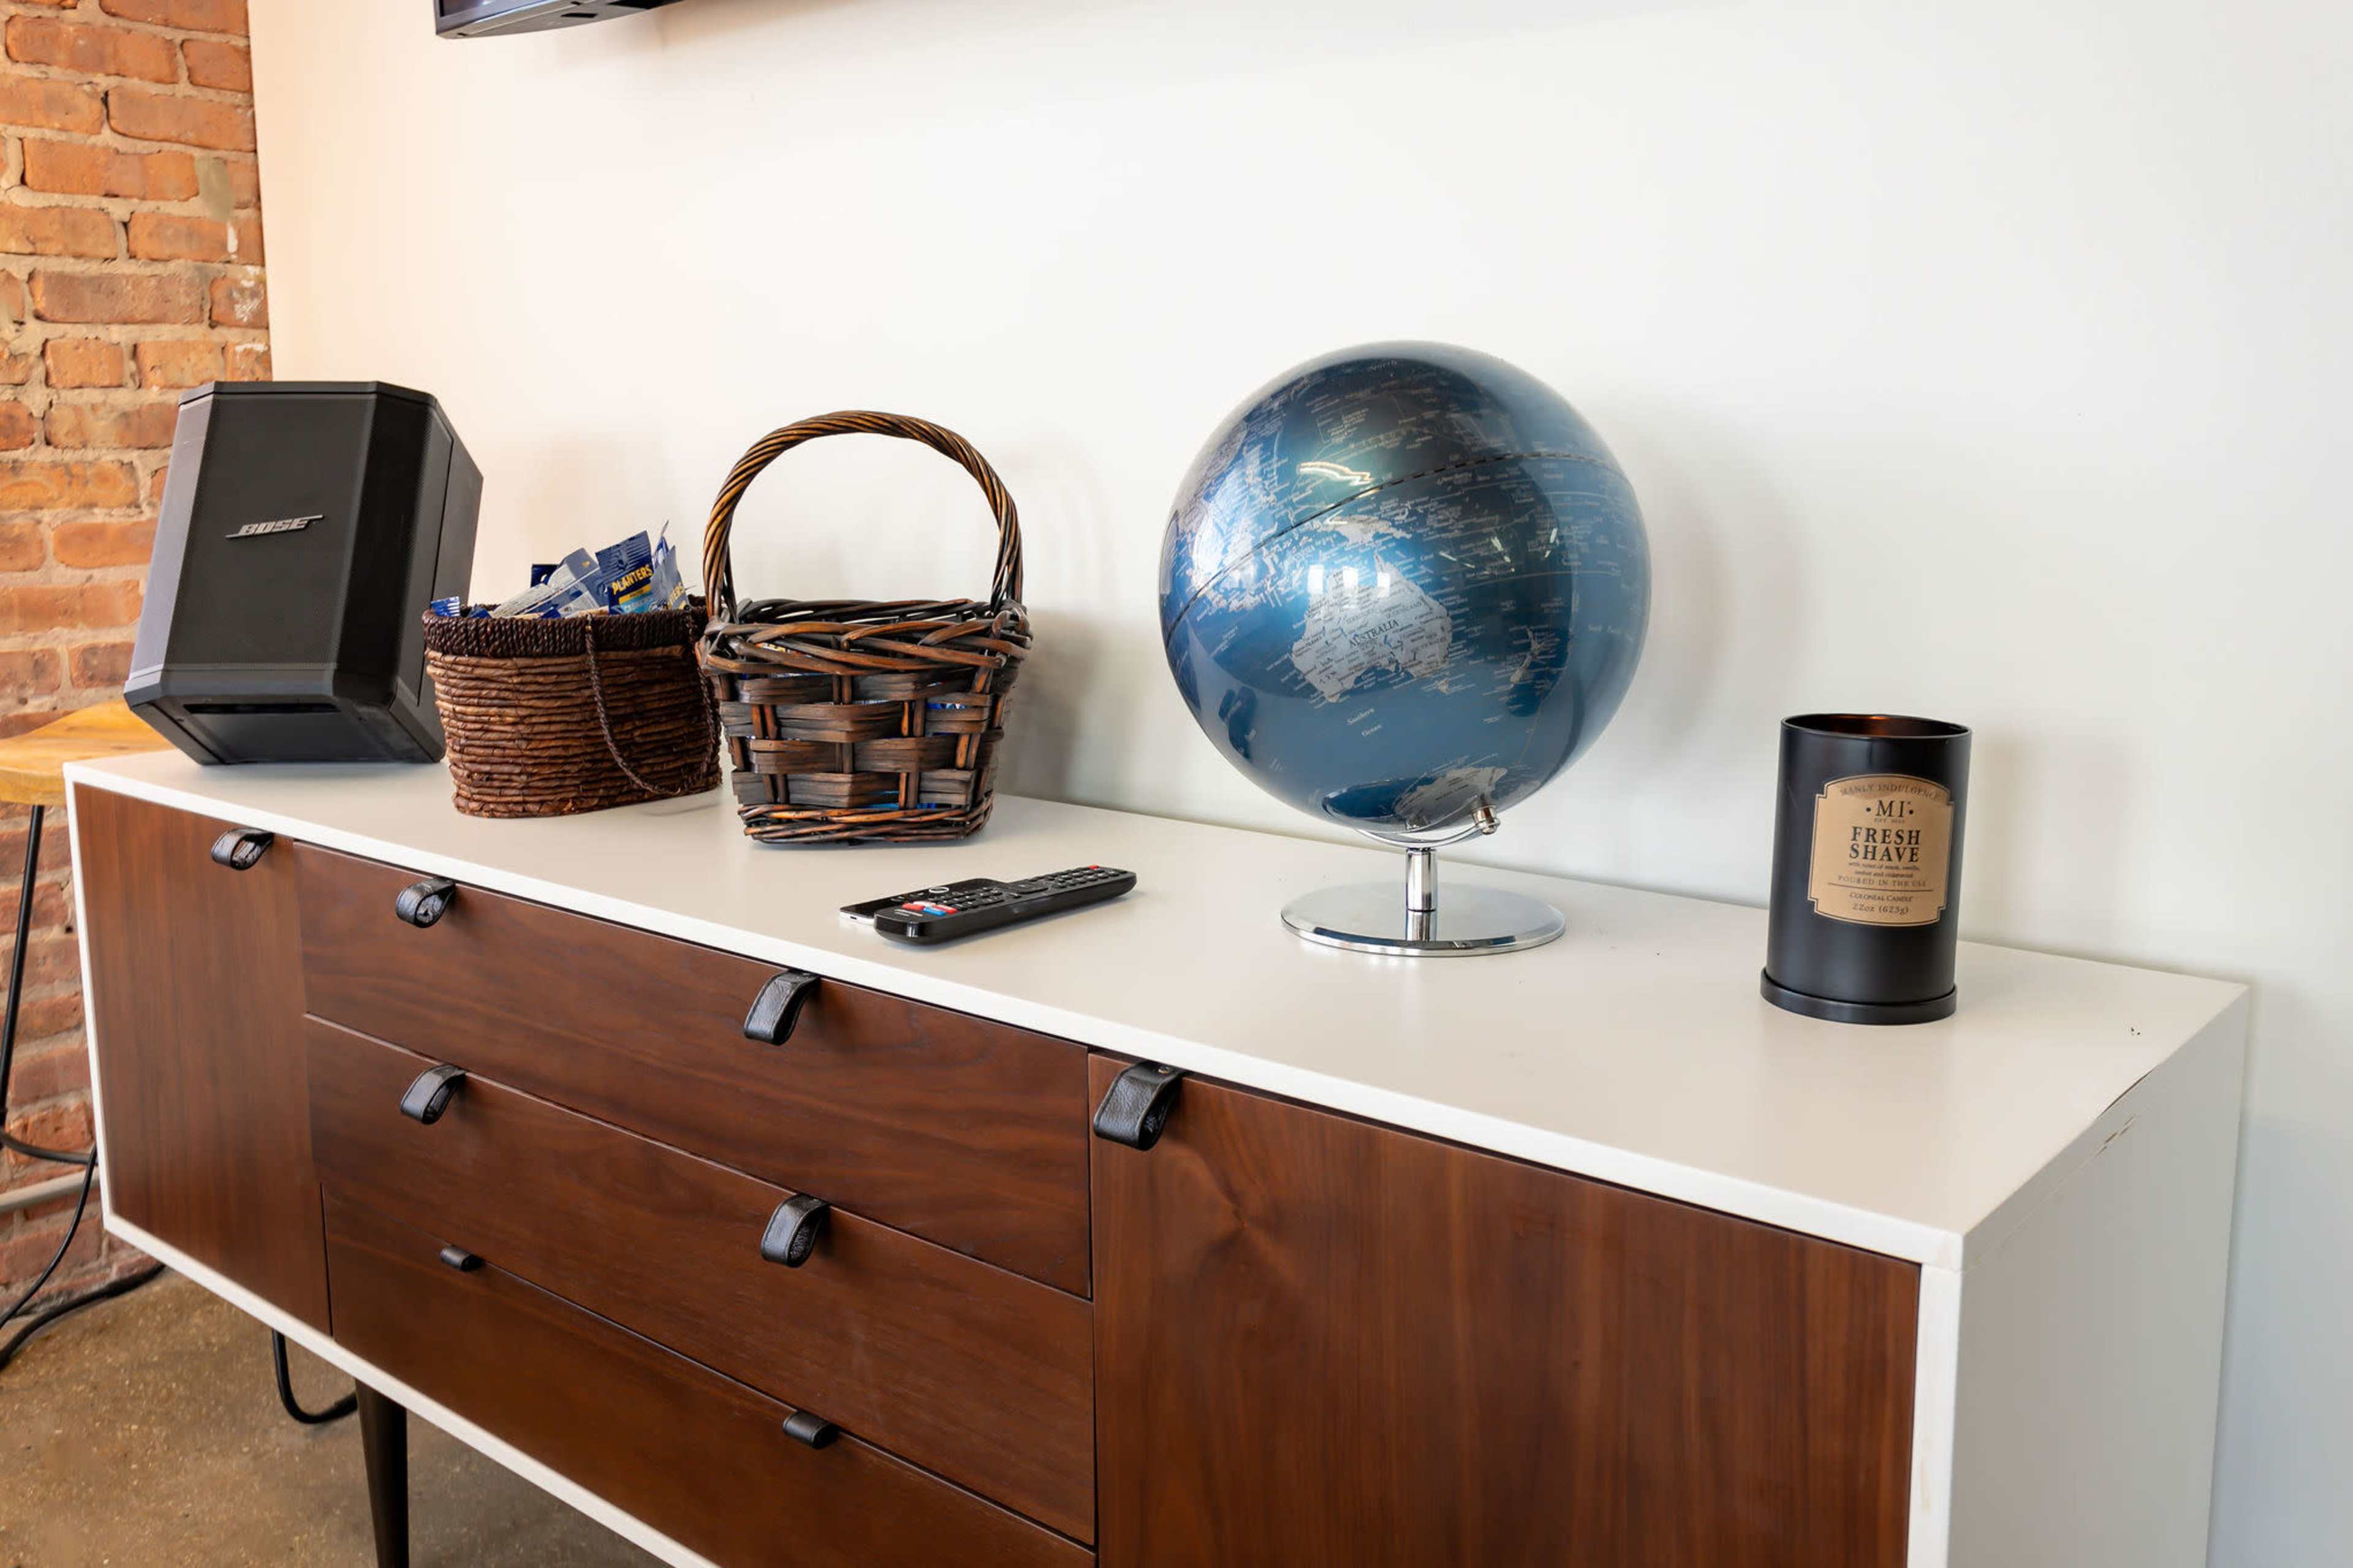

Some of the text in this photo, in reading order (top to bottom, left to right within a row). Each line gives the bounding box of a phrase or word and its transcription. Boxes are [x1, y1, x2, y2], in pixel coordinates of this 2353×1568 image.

[234, 517, 316, 536] BOSE
[612, 564, 653, 595] PLANTERS
[1349, 619, 1398, 648] AUSTRALIA
[1851, 826, 1921, 845] FRESH
[1849, 843, 1919, 863] SHAVE
[1838, 875, 1874, 885] POURED
[1852, 902, 1874, 912] 22oz
